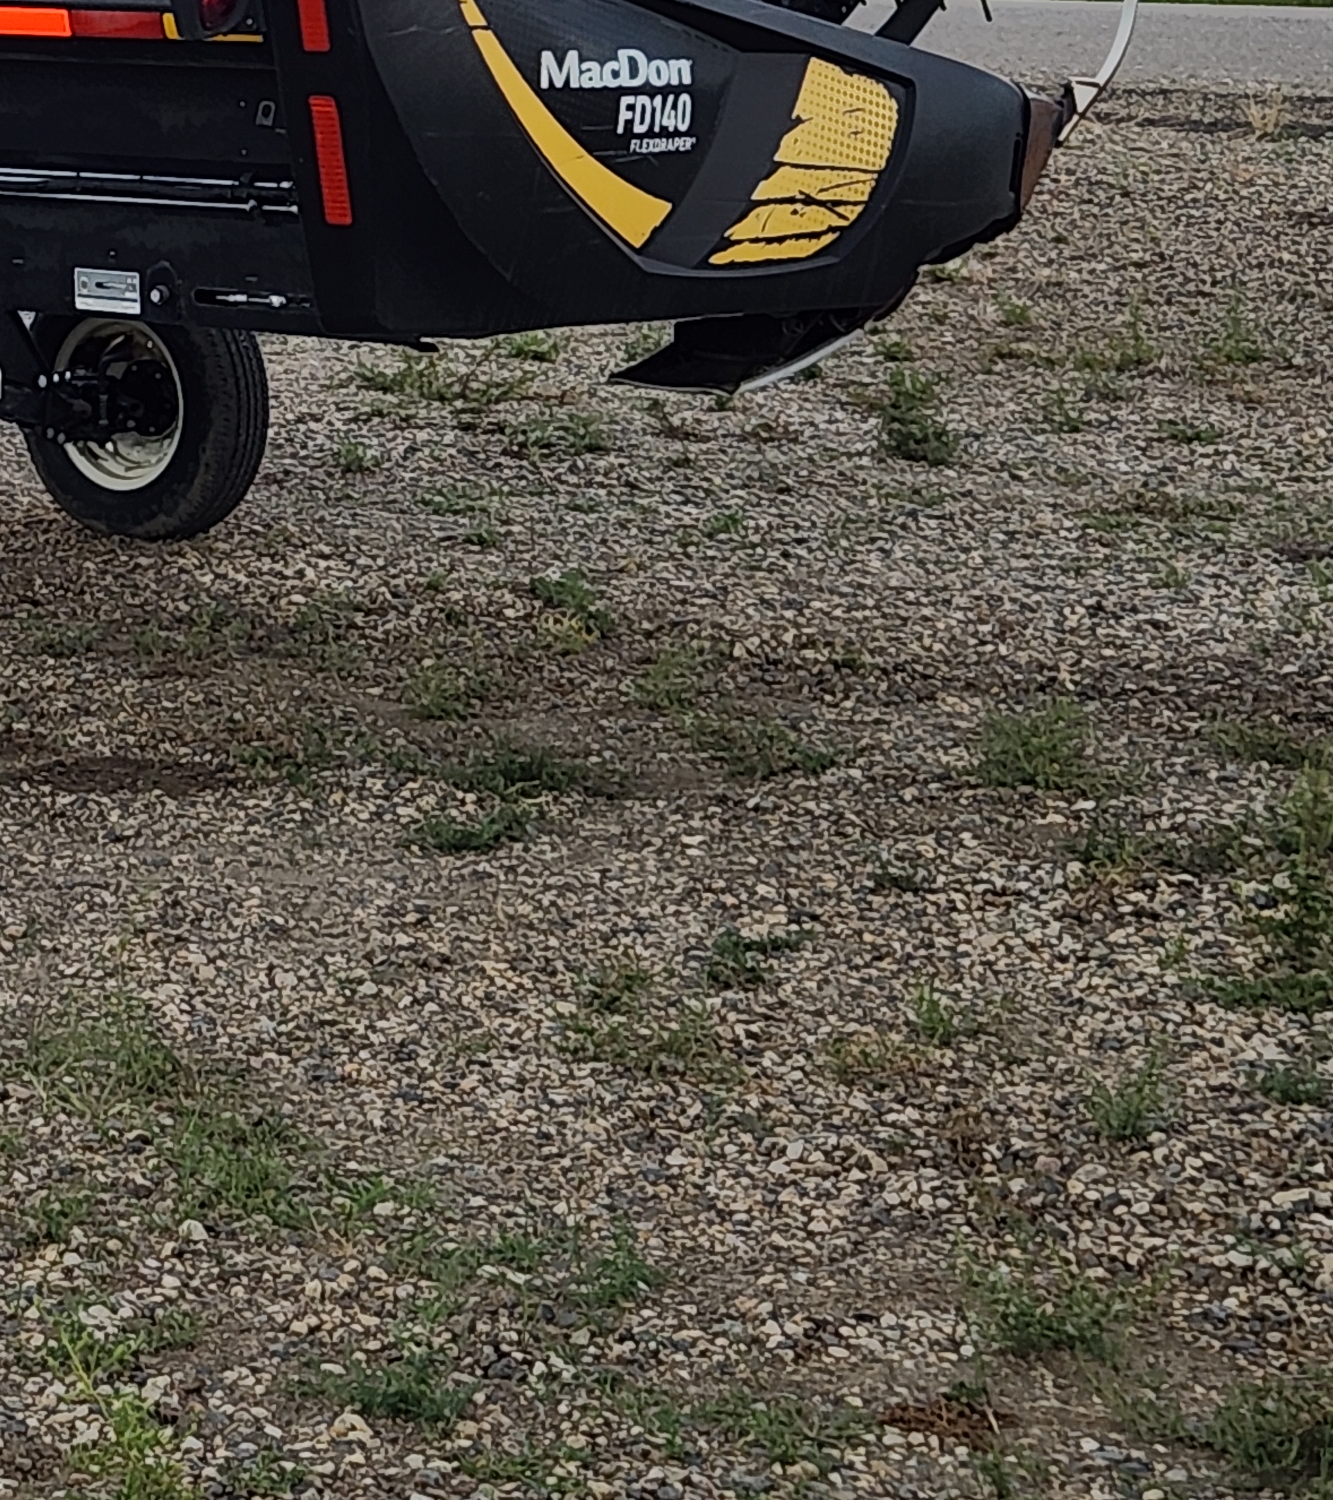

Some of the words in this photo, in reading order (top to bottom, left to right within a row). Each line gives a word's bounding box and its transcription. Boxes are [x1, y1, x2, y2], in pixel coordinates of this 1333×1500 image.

[540, 49, 692, 89] MacDon
[616, 93, 692, 134] FD140
[629, 137, 696, 153] FLEXDRAPER
